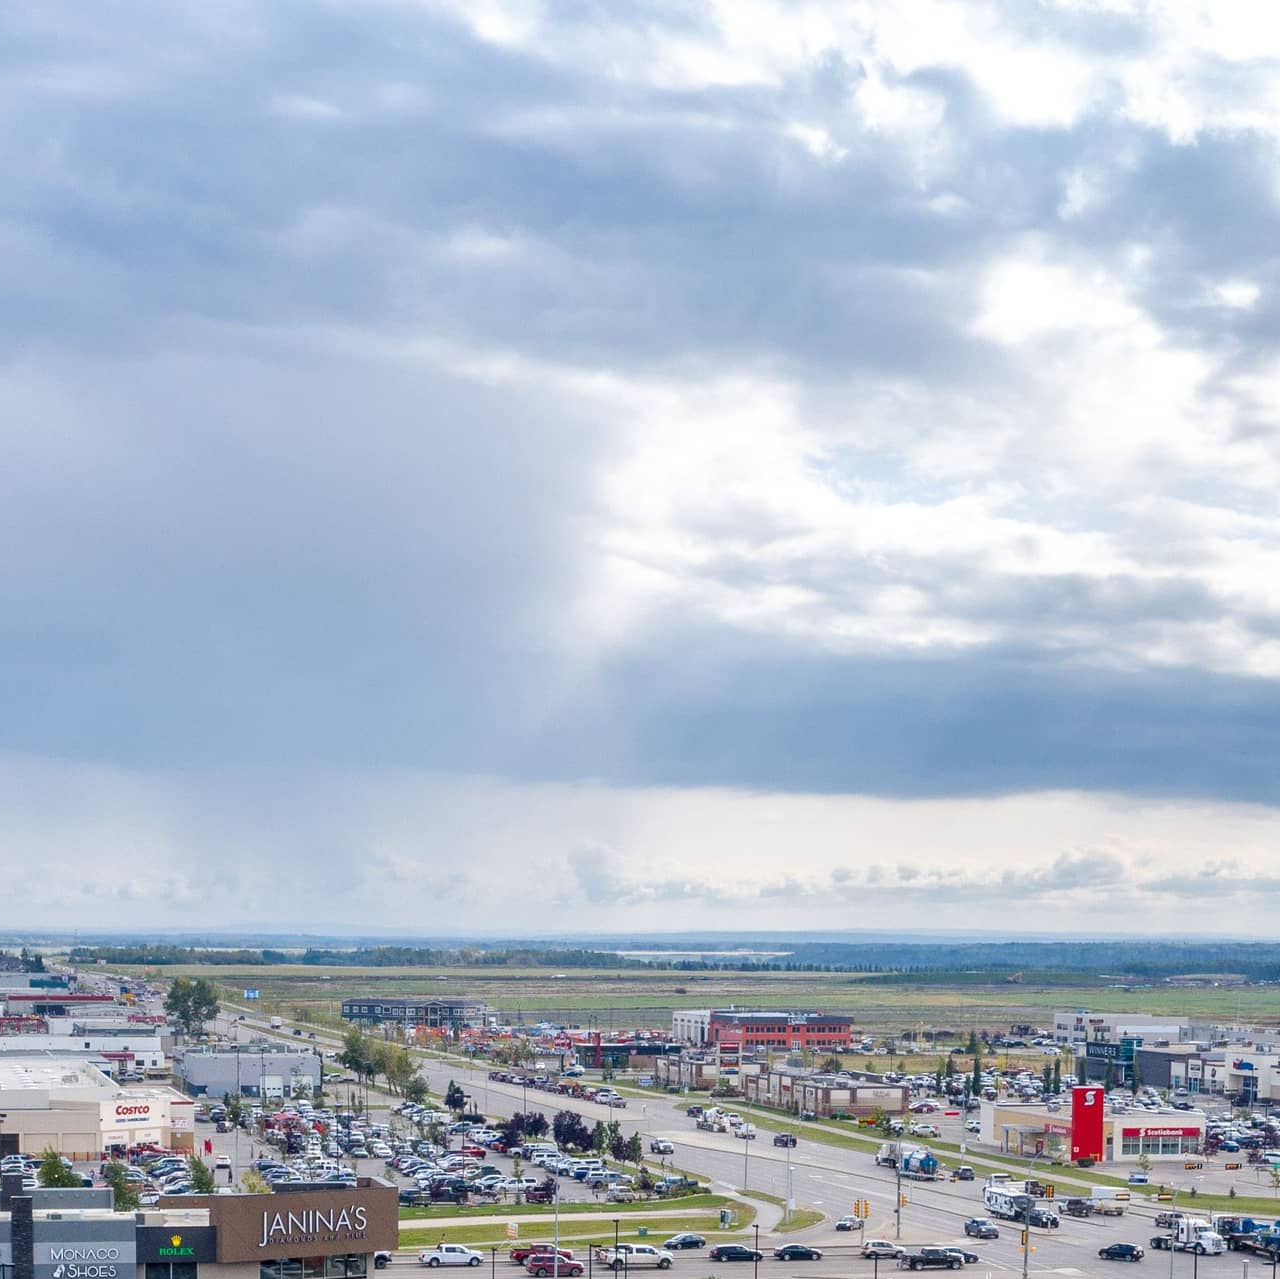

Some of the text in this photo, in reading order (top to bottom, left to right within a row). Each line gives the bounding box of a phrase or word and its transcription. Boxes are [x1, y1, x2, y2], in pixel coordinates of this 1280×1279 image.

[115, 1105, 150, 1116] COSTCO
[259, 1205, 367, 1247] JANINA'S
[50, 1247, 119, 1260] MONACO
[159, 1247, 194, 1256] ROLEX
[67, 1263, 117, 1278] SHOES
